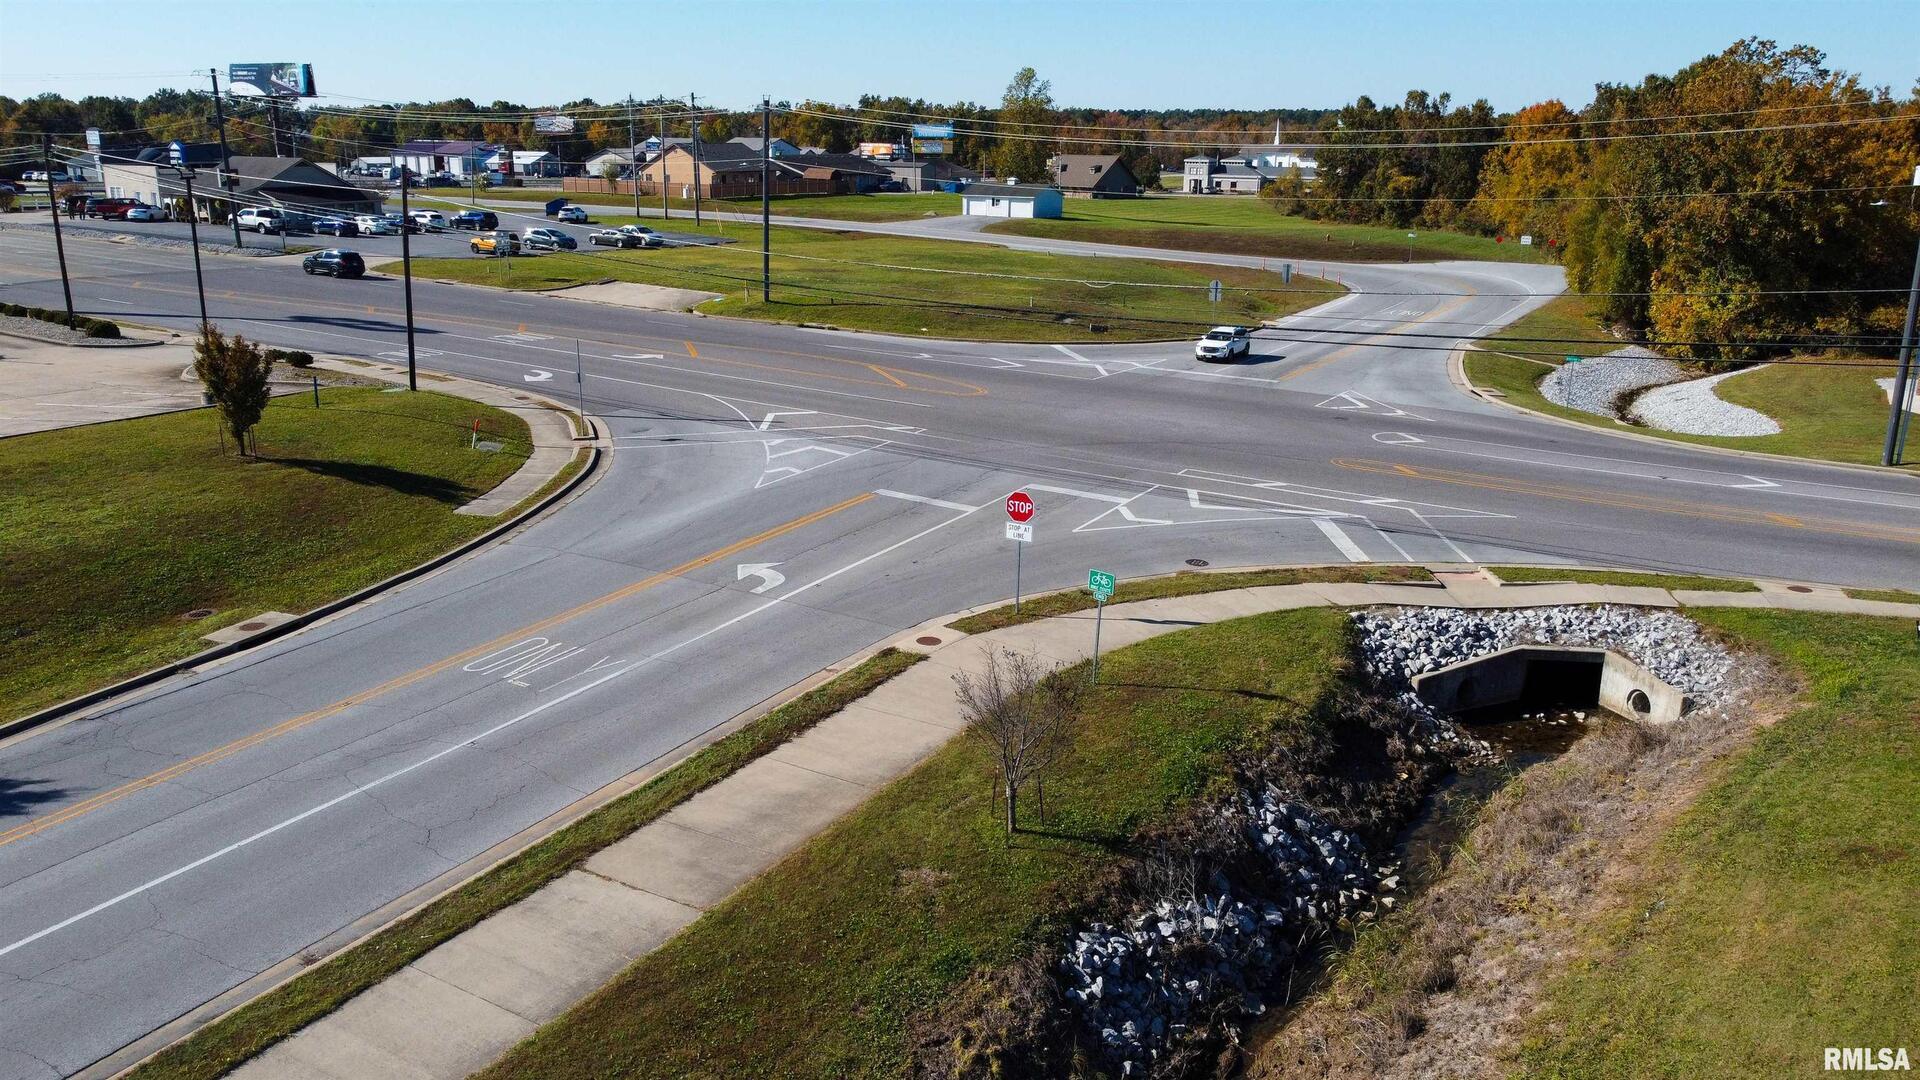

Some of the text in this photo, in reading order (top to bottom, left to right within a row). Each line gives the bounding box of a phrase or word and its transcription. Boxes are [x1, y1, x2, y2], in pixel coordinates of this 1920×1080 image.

[1008, 500, 1032, 514] STOP
[1008, 524, 1021, 532] STOP
[463, 637, 626, 693] ONLY
